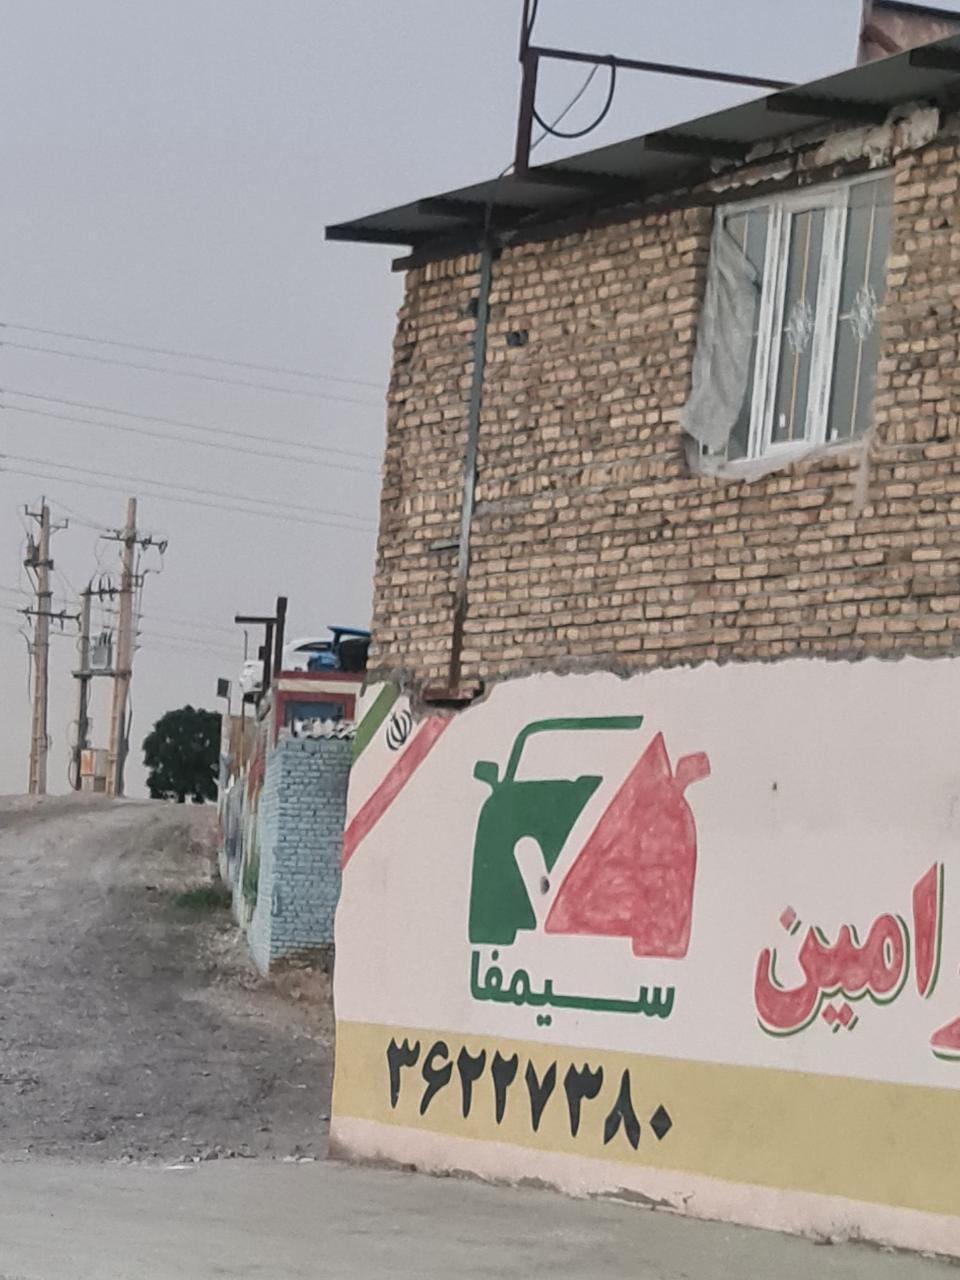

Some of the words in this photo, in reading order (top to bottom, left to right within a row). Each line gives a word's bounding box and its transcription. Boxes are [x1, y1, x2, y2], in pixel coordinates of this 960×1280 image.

[470, 949, 676, 1027] سیمفا
[753, 861, 945, 1038] امین
[386, 1037, 674, 1151] ۳۶۲۲۷۳۸۰
